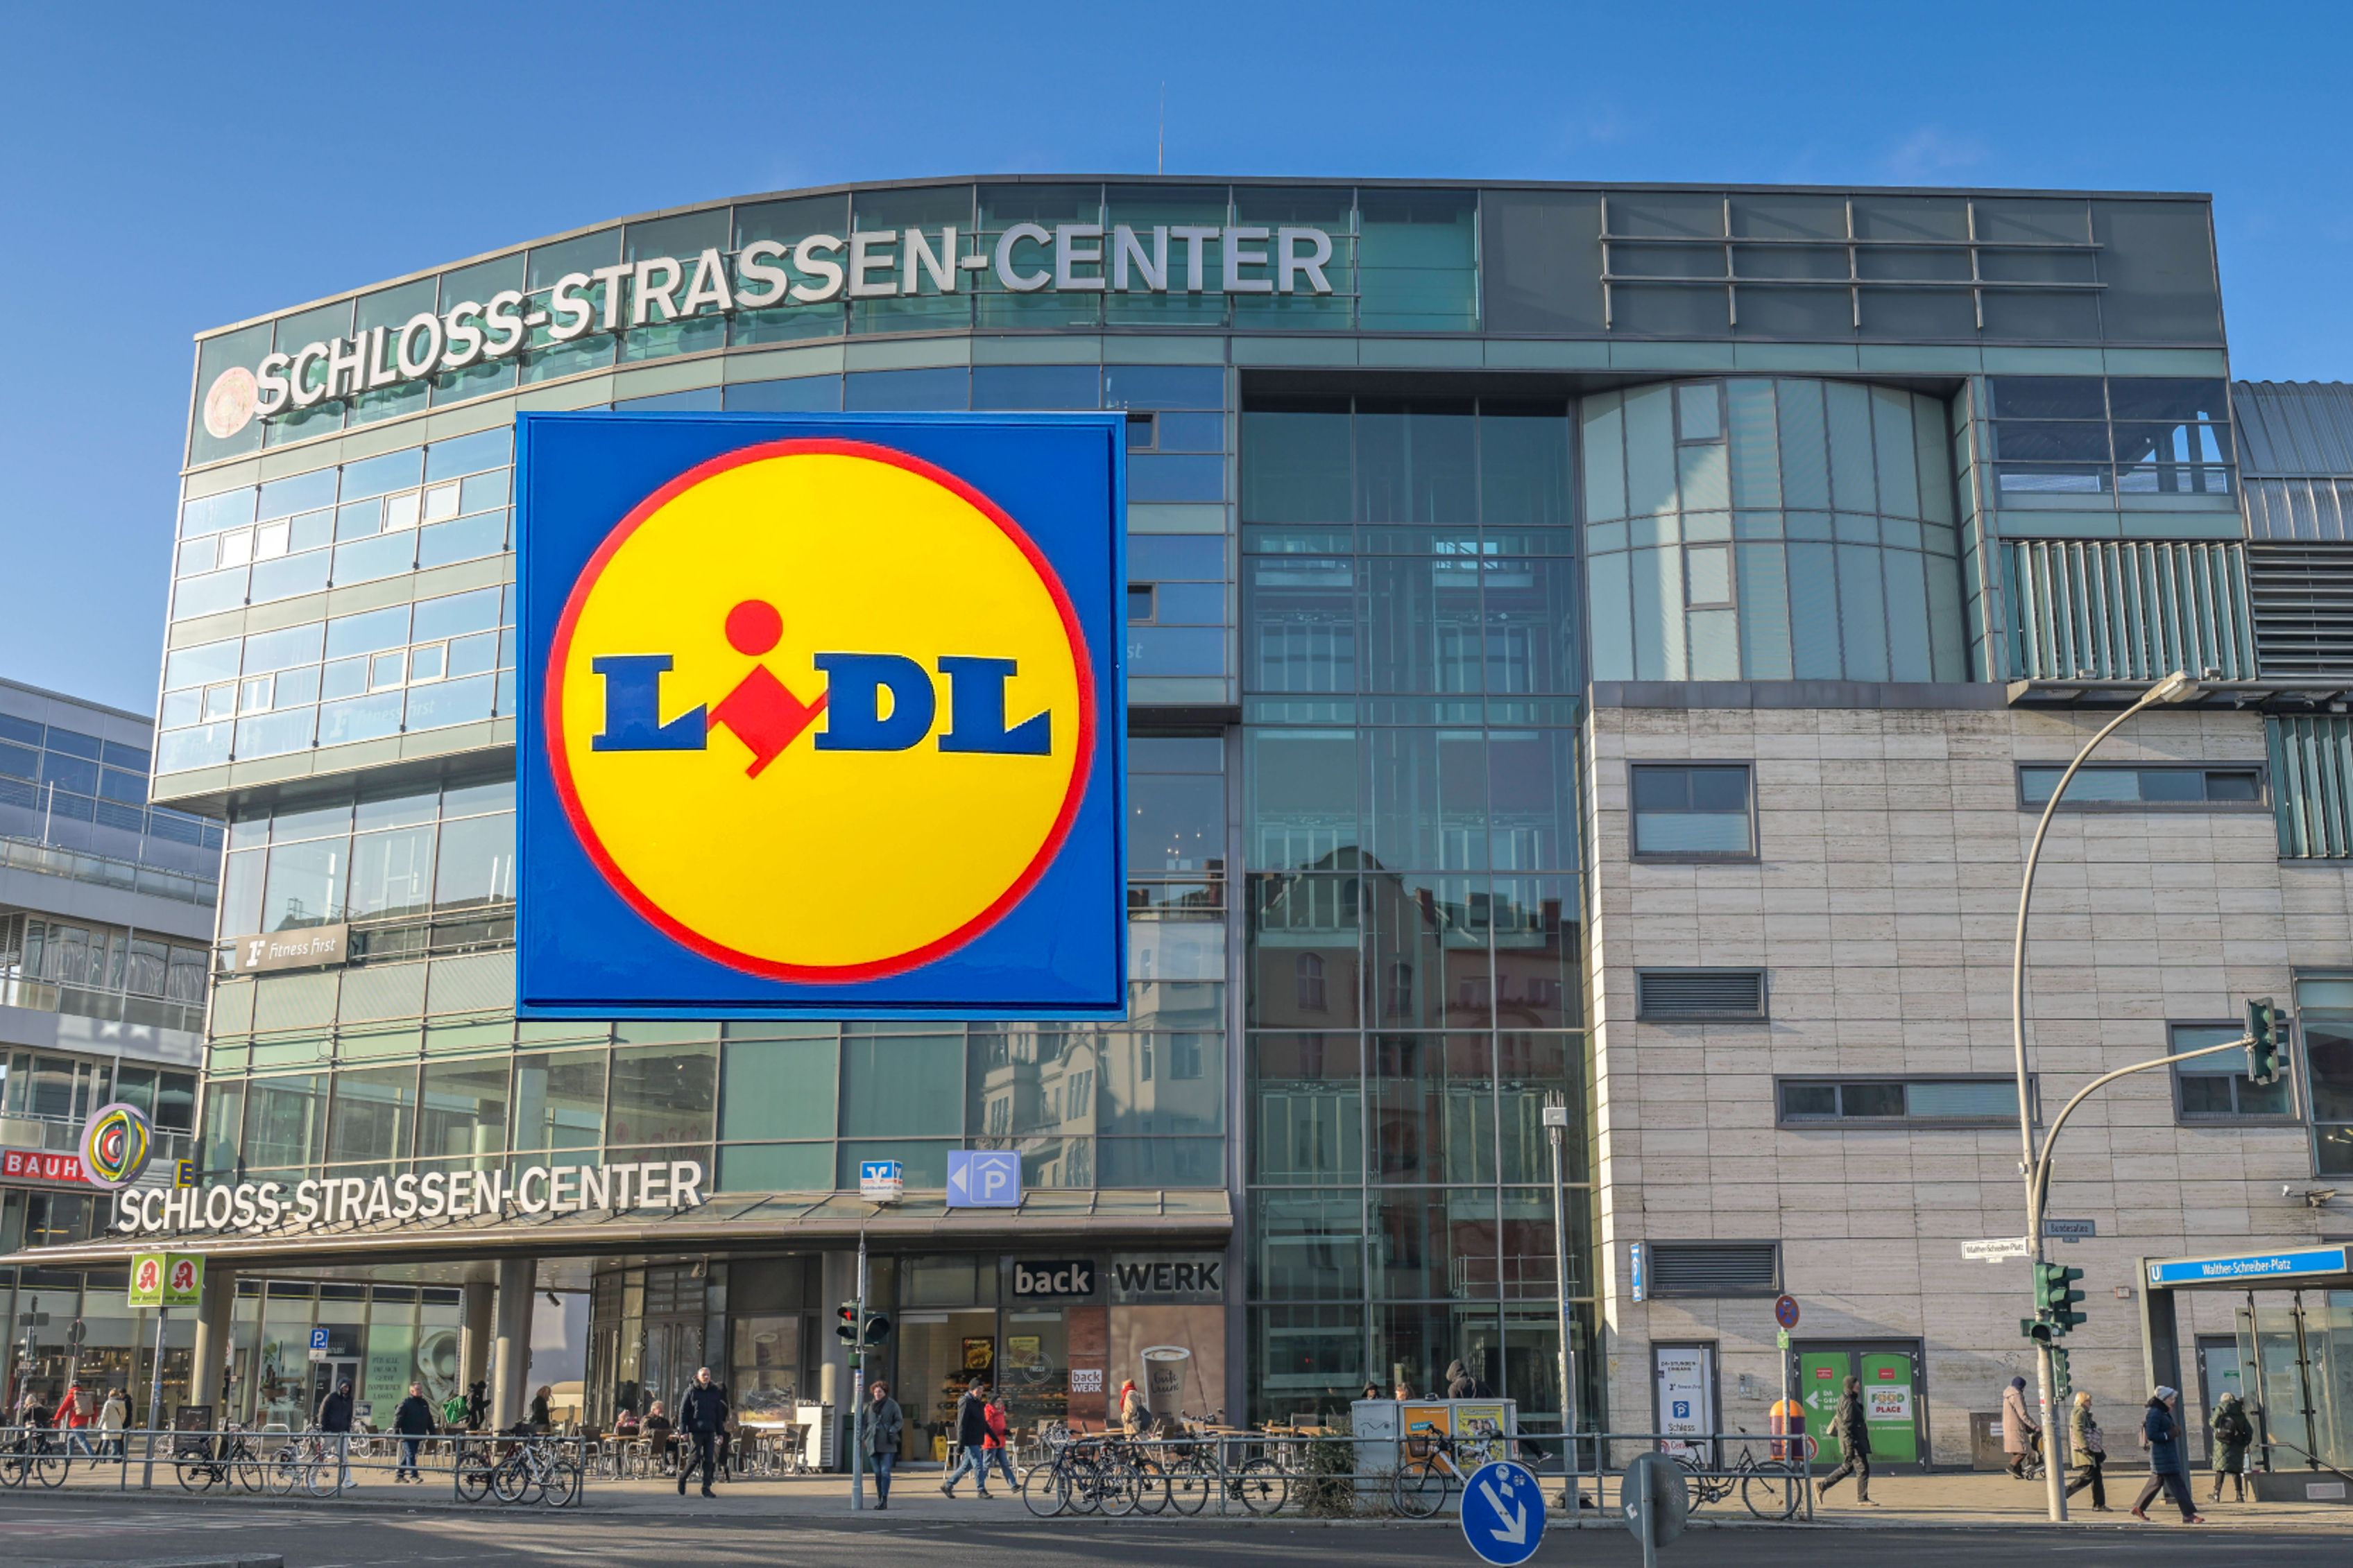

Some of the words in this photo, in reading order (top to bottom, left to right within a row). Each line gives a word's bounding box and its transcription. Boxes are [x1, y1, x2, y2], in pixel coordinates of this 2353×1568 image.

[254, 222, 1333, 416] SCHLOSS-STRASSEN-CENTER
[7, 1154, 86, 1178] BAUH
[118, 1160, 703, 1232] SCHLOSS-STRASSEN-CENTER
[985, 1171, 1007, 1199] P
[1015, 1264, 1090, 1293] back
[1115, 1262, 1220, 1292] WERK
[2151, 1266, 2160, 1281] U
[2202, 1258, 2291, 1276] Walther-Schreiber-Platz
[314, 1331, 324, 1347] P
[1072, 1371, 1100, 1382] back
[1072, 1384, 1102, 1393] WERK
[1871, 1393, 1905, 1404] FOOD
